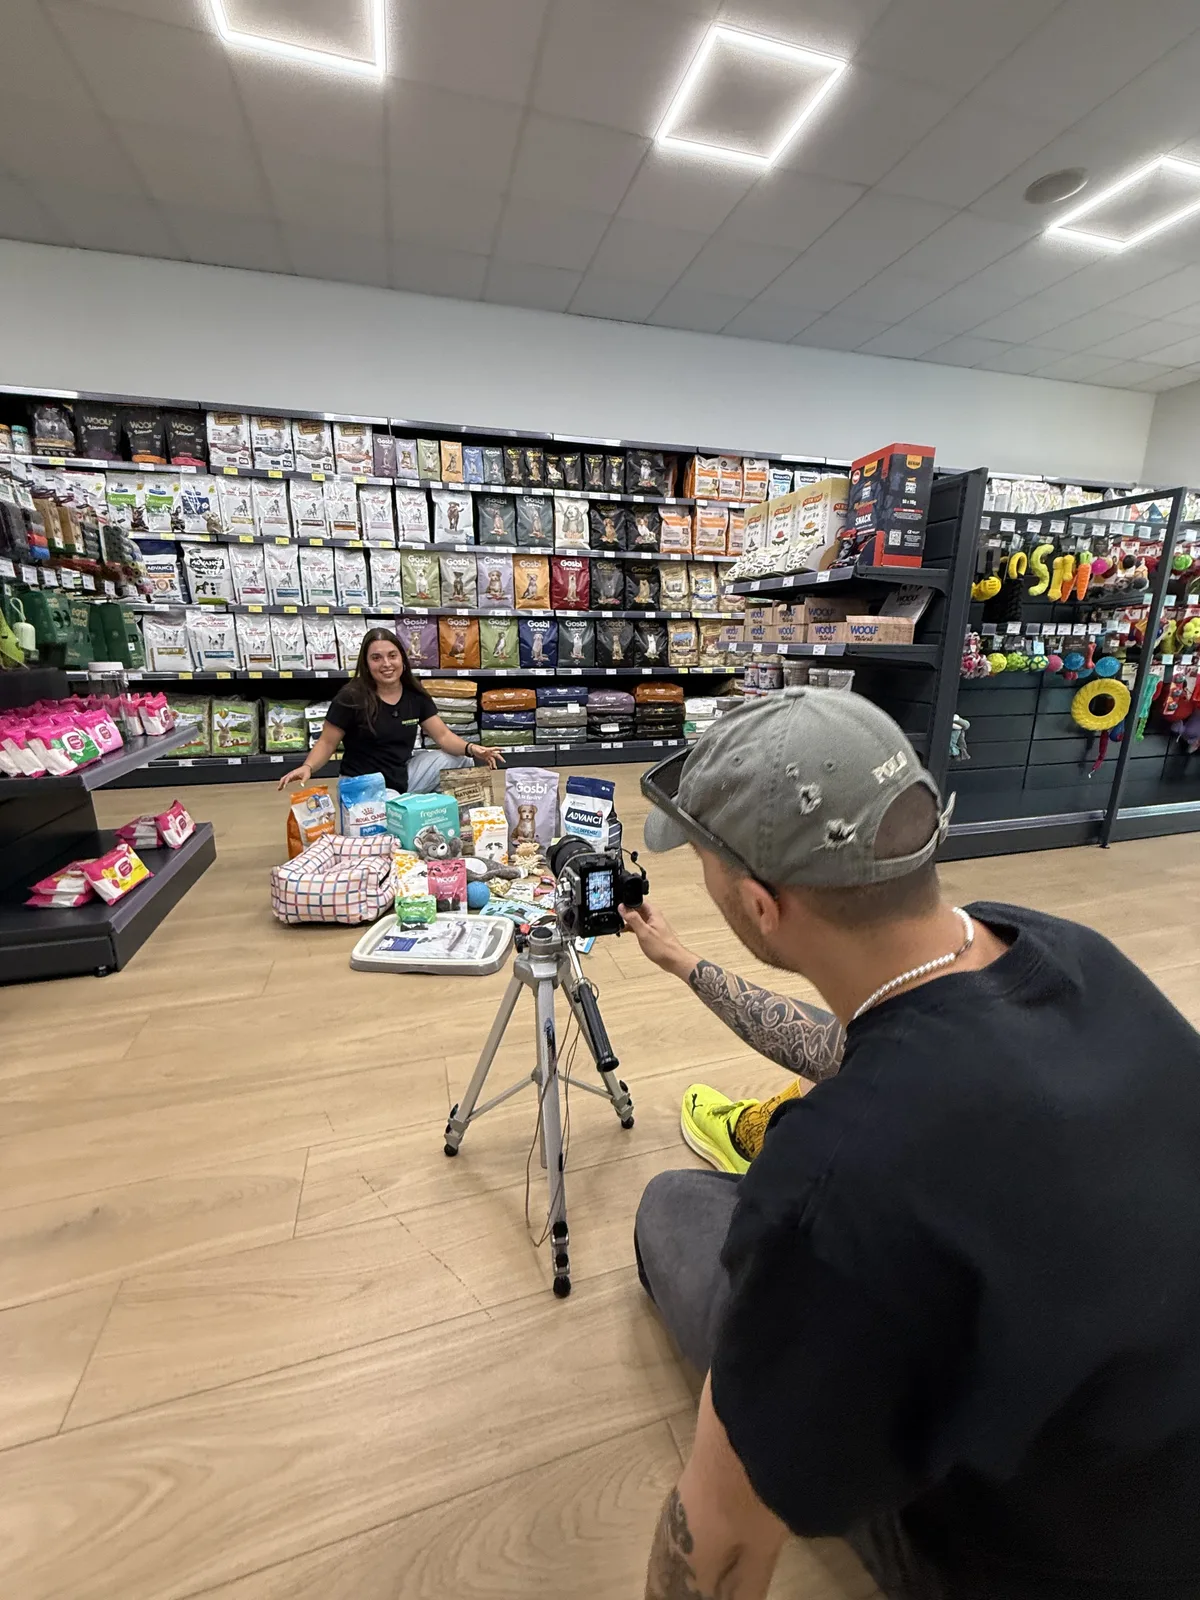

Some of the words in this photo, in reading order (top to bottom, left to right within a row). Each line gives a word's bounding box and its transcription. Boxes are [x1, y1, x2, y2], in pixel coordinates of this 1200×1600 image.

[407, 554, 432, 564] Gosbi
[446, 557, 470, 566] Gosbi
[560, 559, 583, 568] Gosbi
[519, 560, 542, 568] Gosbi
[403, 618, 428, 626] Gosbi
[447, 618, 471, 626] Gosbi
[488, 618, 511, 626] Gosbi
[527, 619, 550, 628] Gosbi
[565, 619, 588, 628] Gosbi
[815, 625, 837, 635] WOOLF
[850, 625, 879, 635] WOOLF
[516, 782, 549, 795] Gosbi
